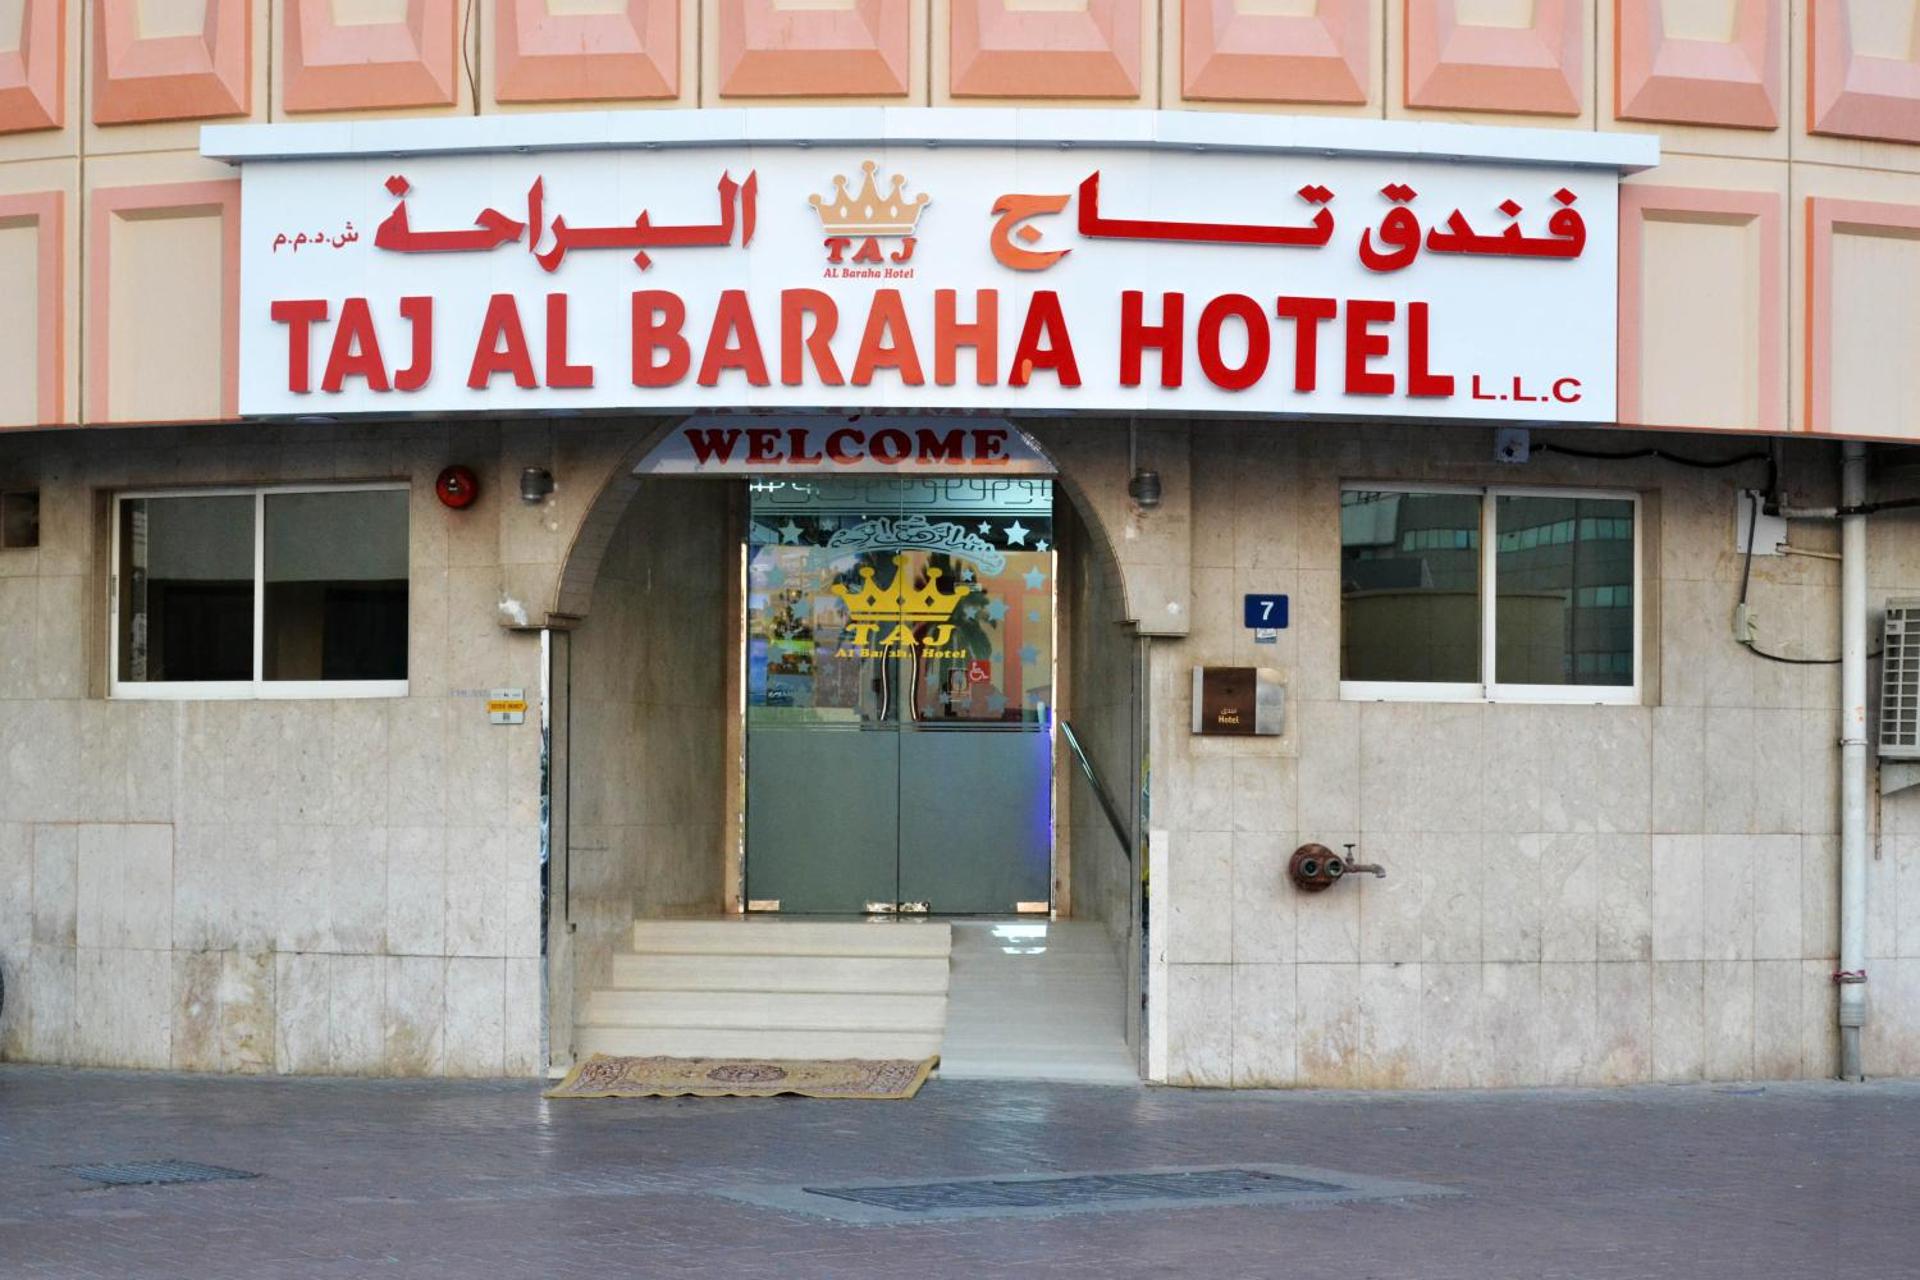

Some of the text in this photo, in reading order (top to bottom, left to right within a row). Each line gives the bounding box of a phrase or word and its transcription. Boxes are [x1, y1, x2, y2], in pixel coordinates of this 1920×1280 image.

[374, 168, 759, 273] البراحة
[990, 170, 1336, 272] تاج
[1357, 184, 1588, 273] فندق
[823, 236, 918, 264] TAJ
[823, 268, 914, 278] AL Baraha Hotel
[270, 287, 1583, 404] TAJ AL BARAHA HOTEL L.L.C
[684, 428, 1011, 467] WELCOME
[1259, 600, 1275, 621] 7
[845, 623, 957, 647] TAJ
[921, 648, 968, 660] Hotel
[1218, 714, 1240, 724] Hotel
